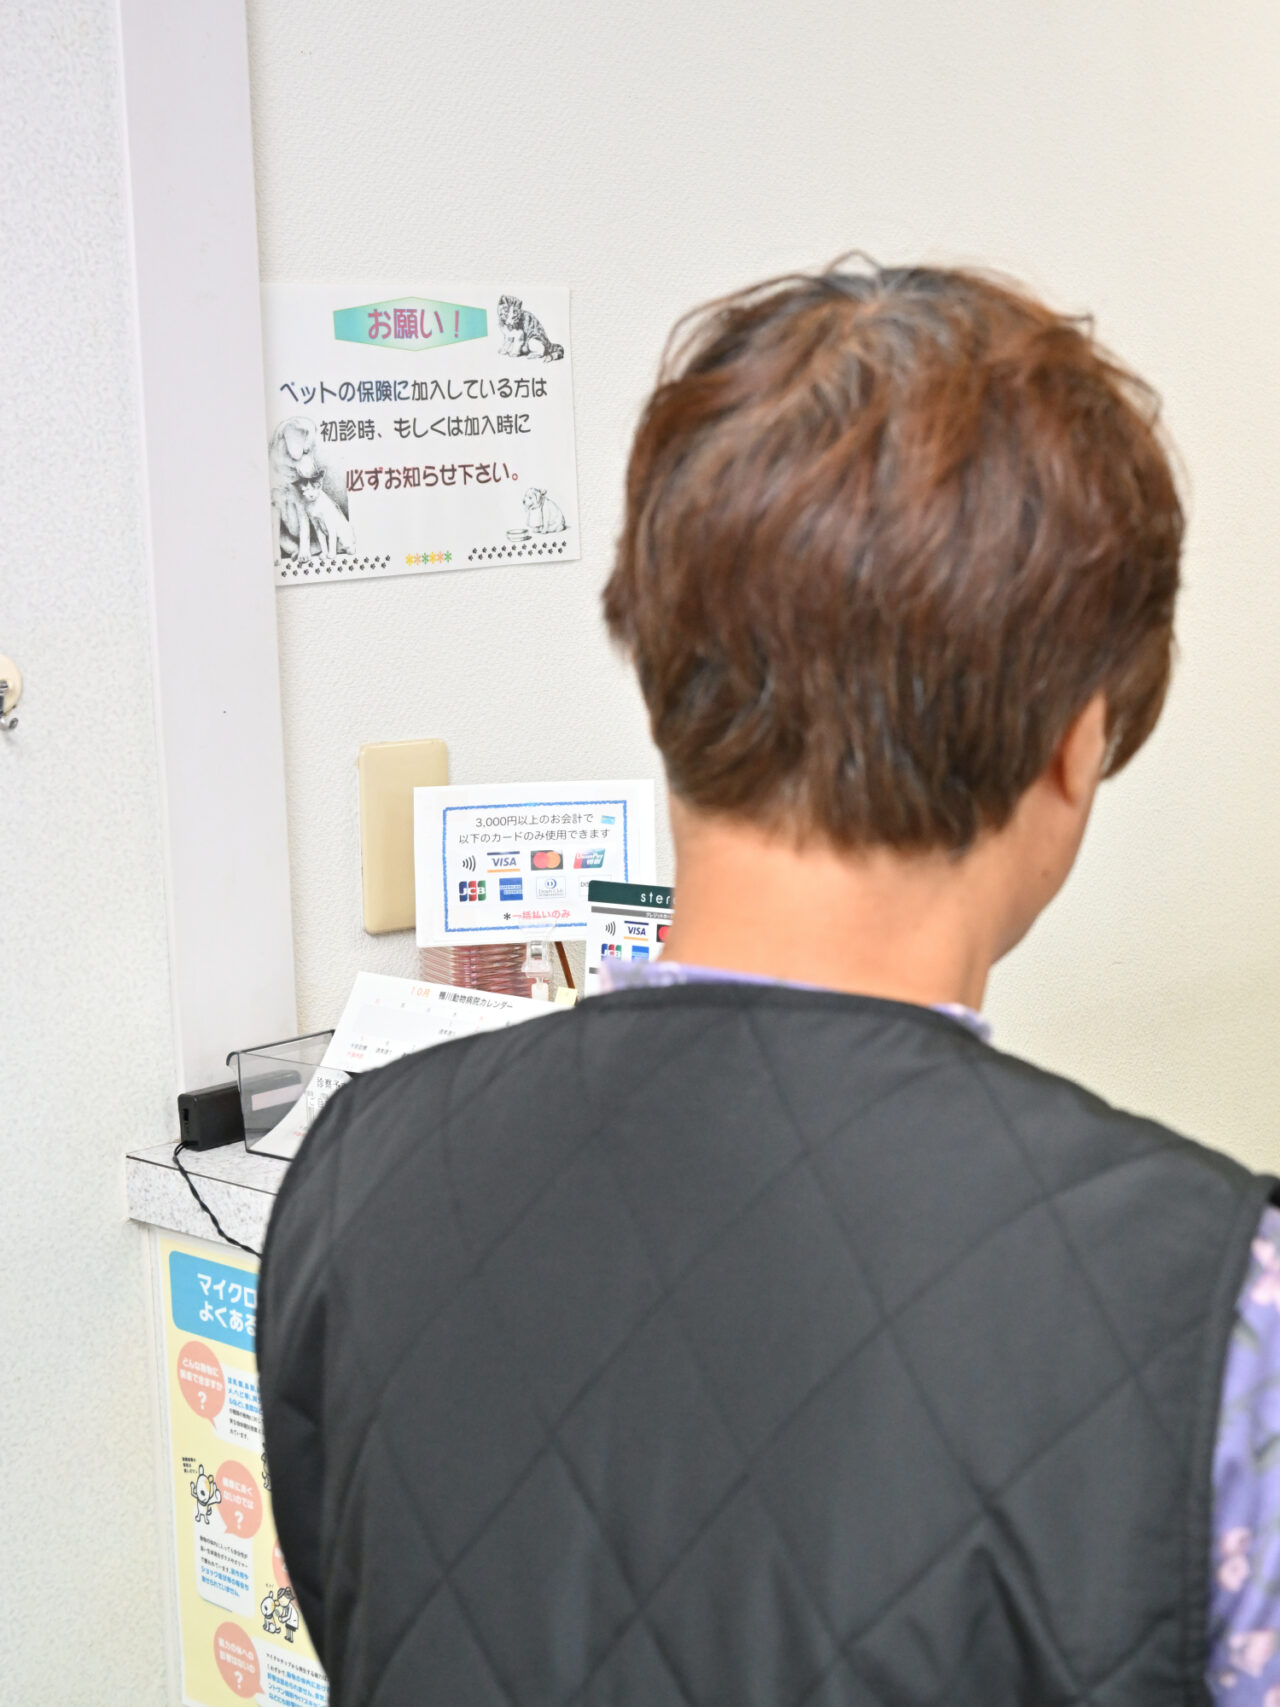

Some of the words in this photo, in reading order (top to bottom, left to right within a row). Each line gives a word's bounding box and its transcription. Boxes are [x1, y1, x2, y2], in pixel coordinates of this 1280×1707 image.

[367, 308, 460, 339] お願い！
[279, 377, 548, 405] ペットの保険に加入している方は
[319, 414, 532, 442] 初診時、もしくは加入時に
[345, 462, 519, 492] 必ずお知らせ下さい。
[475, 813, 594, 828] 3,000円以上のお会計で
[459, 828, 611, 844] 以下のカードのみ使用できます
[492, 857, 517, 867] VISA
[640, 891, 675, 905] ster
[627, 926, 646, 936] VISA
